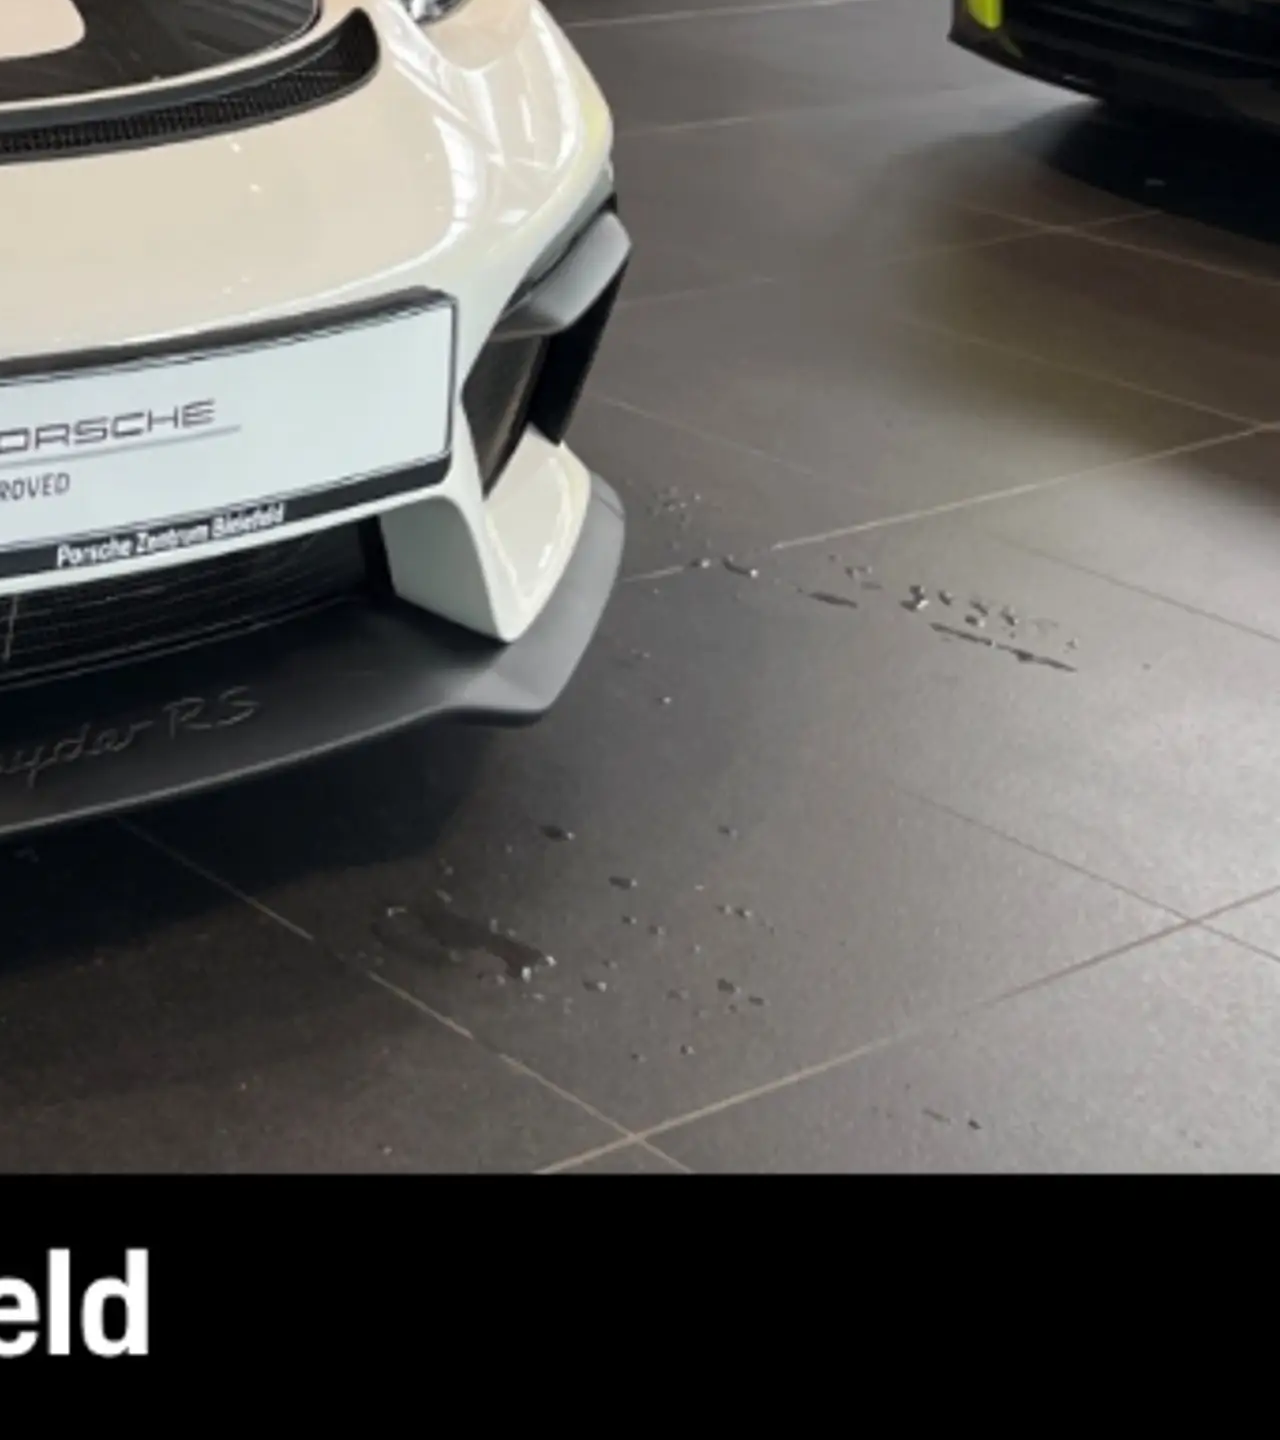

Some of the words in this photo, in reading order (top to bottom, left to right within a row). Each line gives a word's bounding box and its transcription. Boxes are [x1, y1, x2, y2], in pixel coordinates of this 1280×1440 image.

[56, 536, 133, 568] Porsche
[135, 522, 209, 553] Zentrum
[211, 502, 285, 538] Bielefeld
[160, 685, 260, 740] RS
